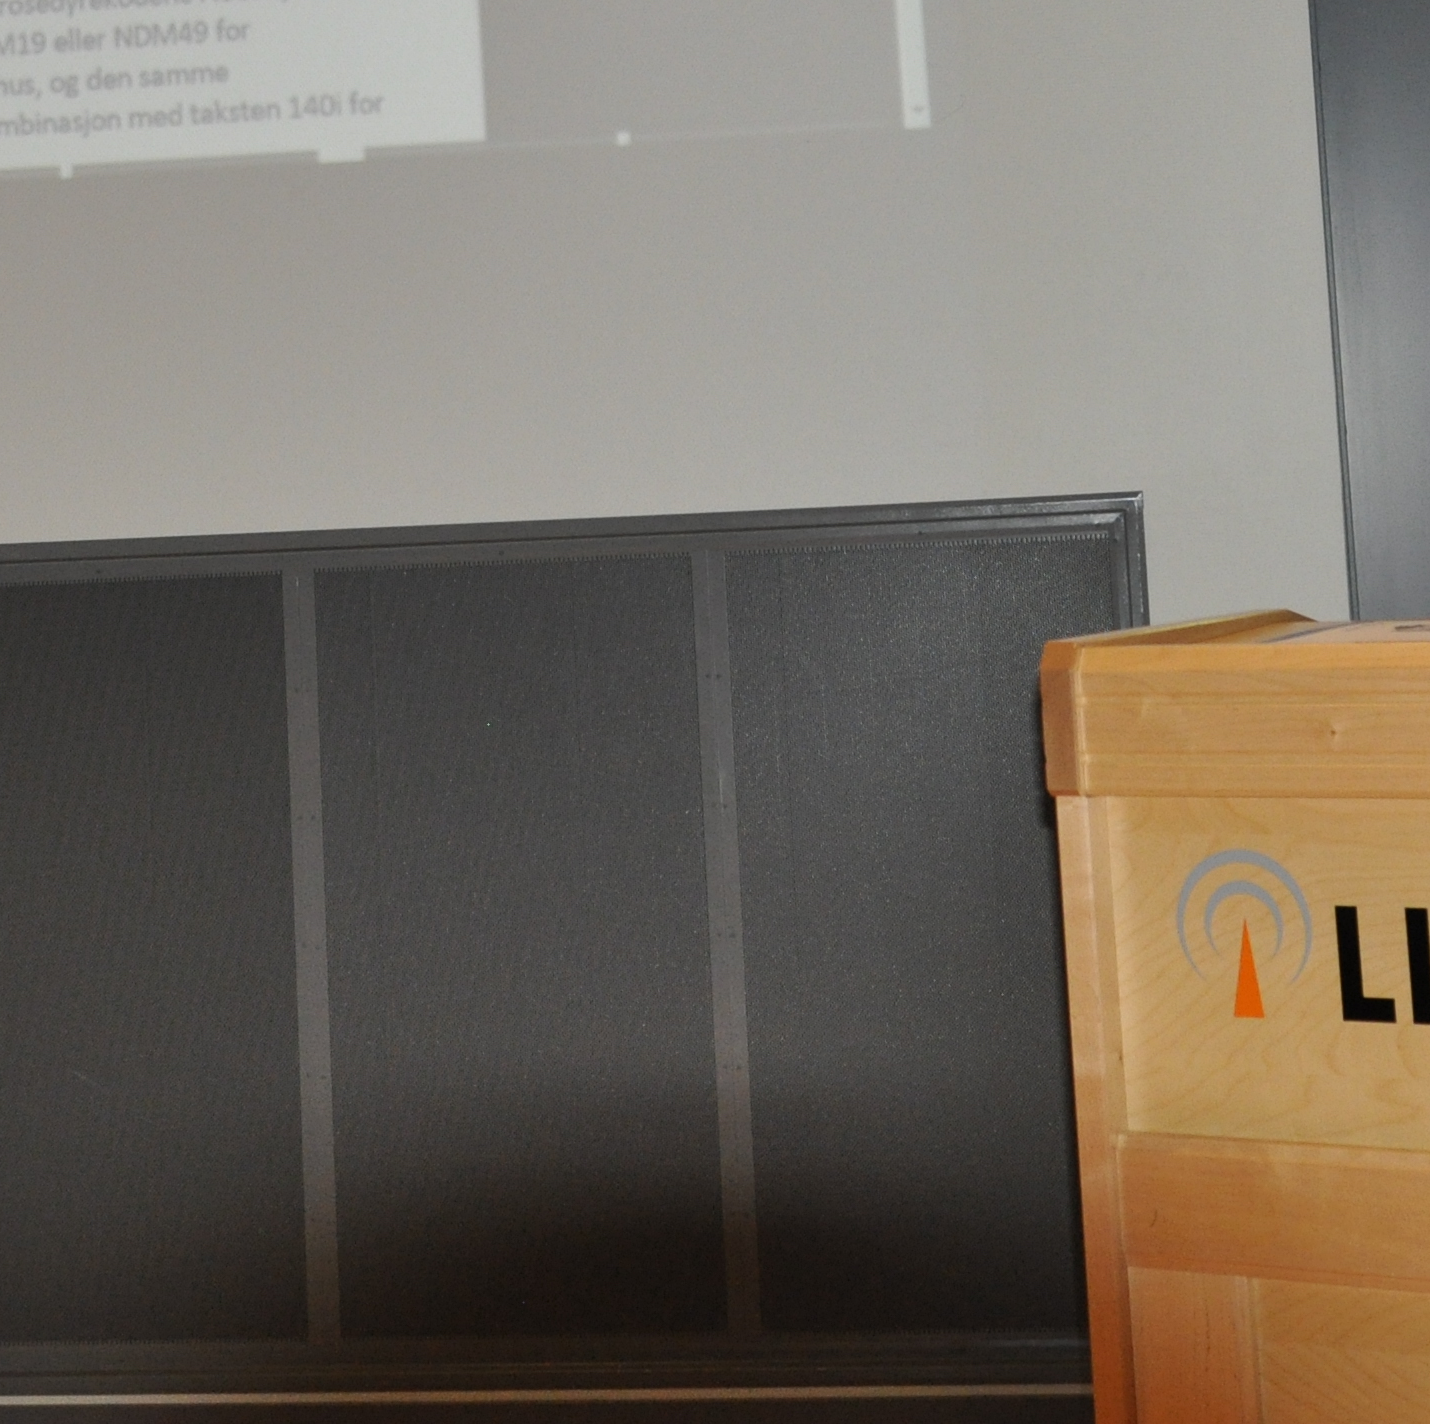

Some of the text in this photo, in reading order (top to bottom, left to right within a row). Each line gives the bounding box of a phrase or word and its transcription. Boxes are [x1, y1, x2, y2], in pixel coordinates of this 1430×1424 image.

[51, 26, 106, 54] eller
[214, 16, 251, 43] for
[47, 73, 81, 100] og
[84, 66, 134, 93] den
[138, 63, 231, 89] samme
[126, 101, 185, 130] med
[187, 99, 283, 127] taksten
[347, 89, 385, 116] for
